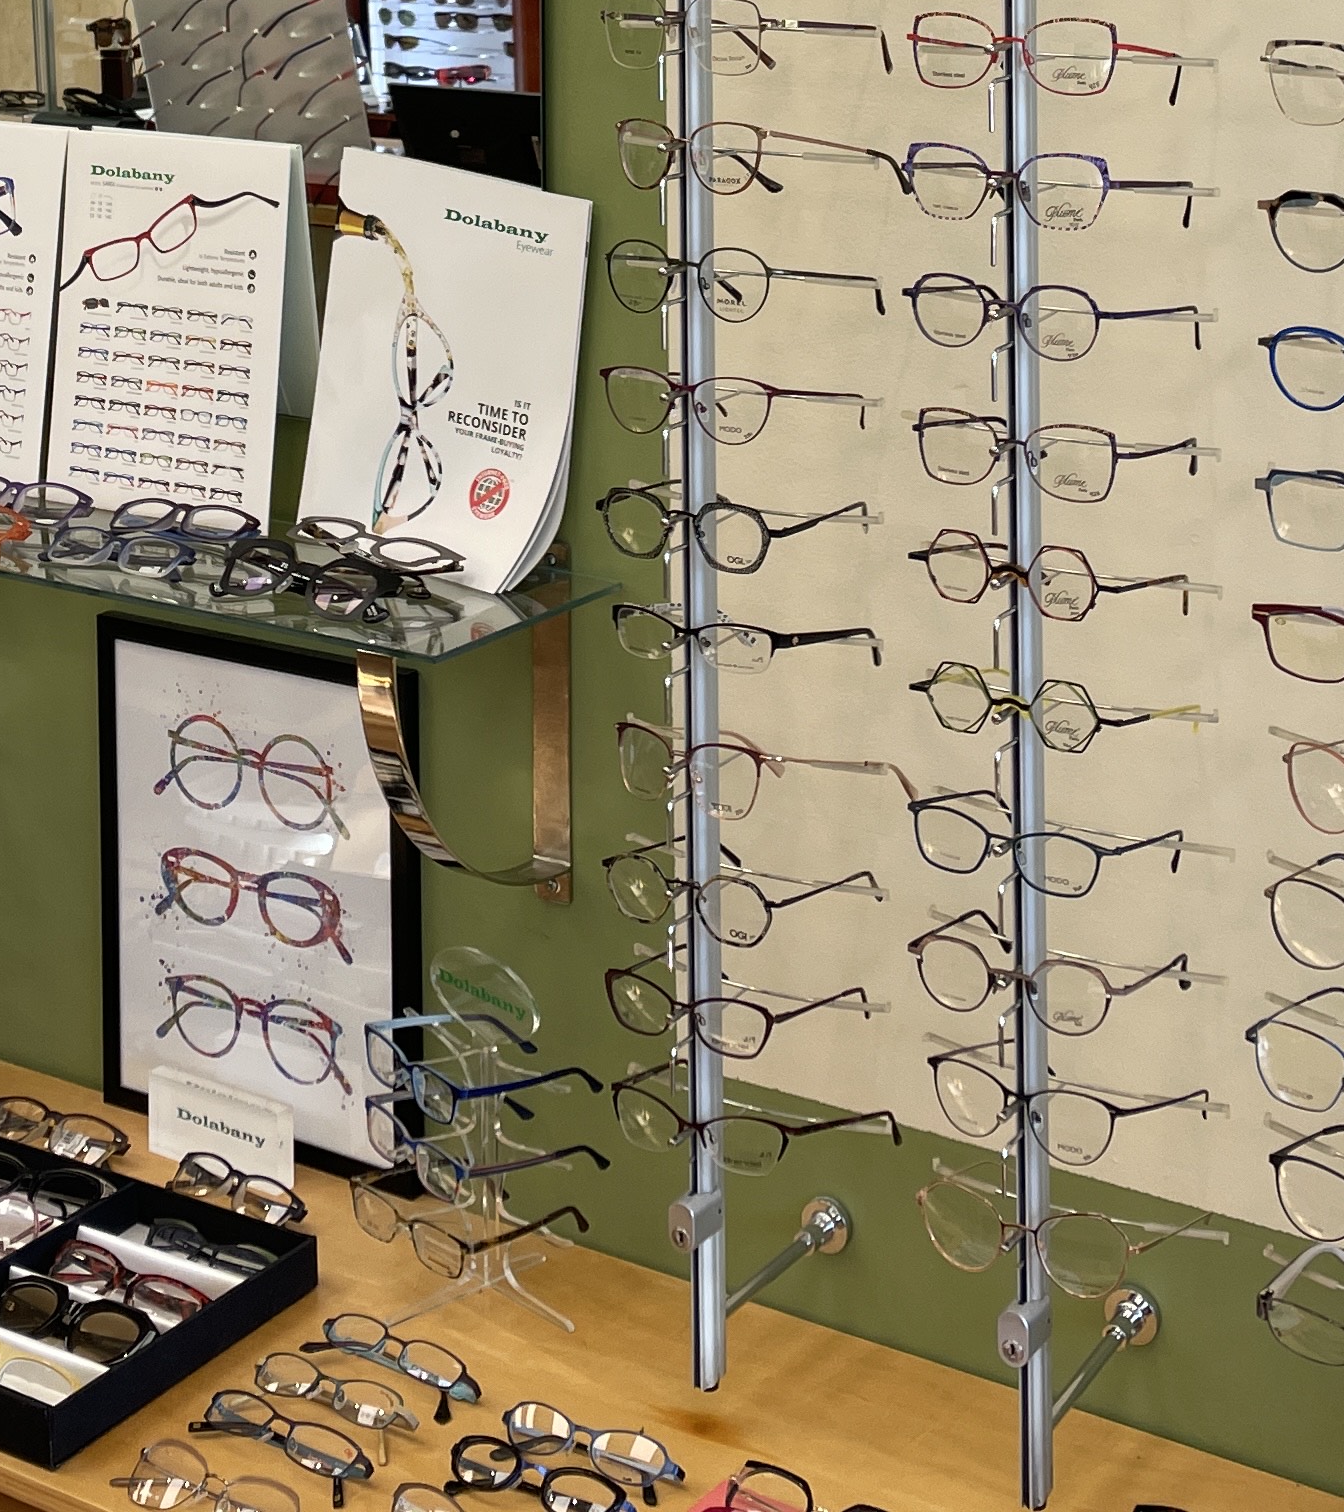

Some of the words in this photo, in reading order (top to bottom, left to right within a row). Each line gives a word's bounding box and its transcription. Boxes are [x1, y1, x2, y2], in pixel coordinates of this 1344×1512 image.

[90, 164, 176, 185] Dolabany
[1044, 201, 1084, 221] Plume
[444, 207, 549, 244] Dolabany
[516, 240, 554, 257] Eyewear
[1041, 332, 1075, 349] Plume
[478, 402, 509, 421] TIME
[512, 411, 529, 426] TO
[514, 400, 522, 409] IS
[523, 401, 531, 410] IT
[448, 410, 527, 441] RECONSIDER
[718, 425, 742, 434] MODO
[455, 427, 474, 438] YOUR
[475, 432, 525, 452] FRAME-BUYING
[491, 447, 523, 461] LOYALTY?
[1053, 472, 1088, 488] Plume
[729, 929, 748, 941] OGI
[438, 967, 526, 1021] Dolabany
[176, 1106, 266, 1149] Dolabany
